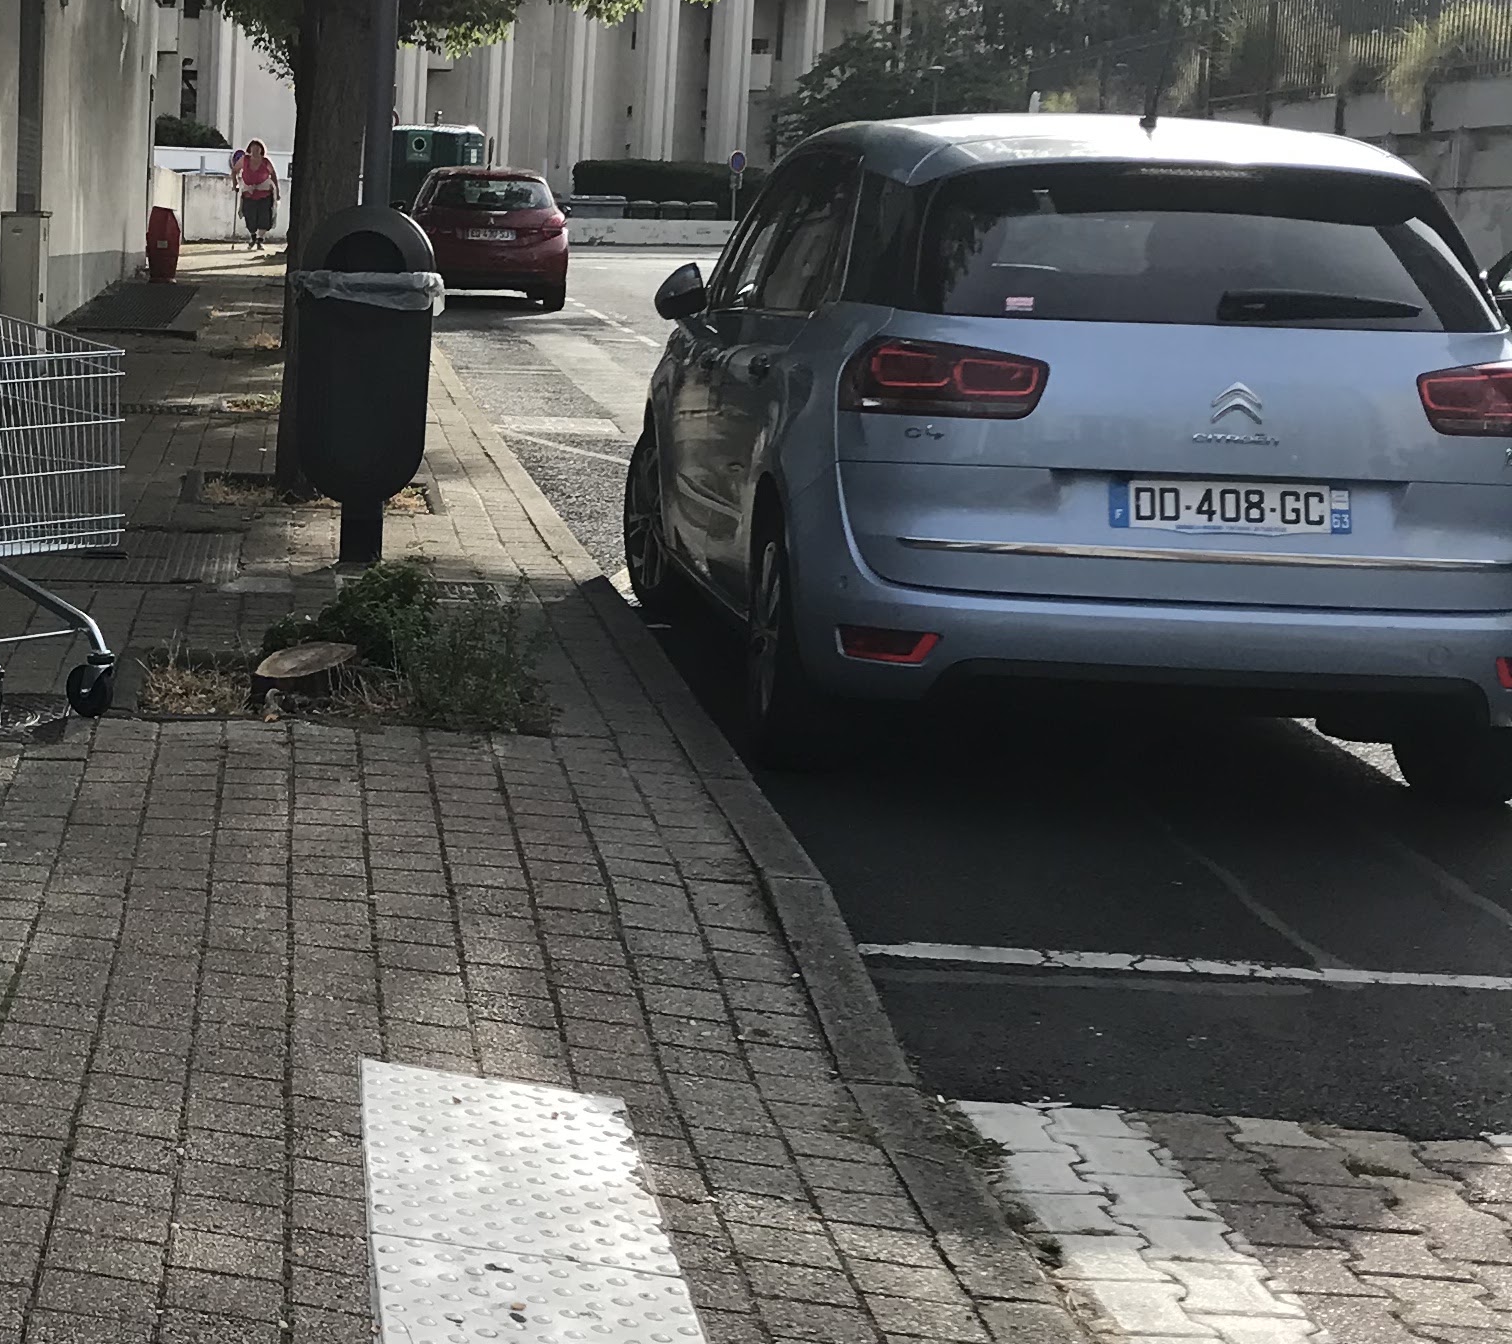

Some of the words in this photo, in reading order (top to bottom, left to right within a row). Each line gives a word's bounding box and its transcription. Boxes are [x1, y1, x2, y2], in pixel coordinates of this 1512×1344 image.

[1135, 487, 1325, 525] DD-408-GC
[1114, 509, 1123, 520] F
[1331, 514, 1350, 529] 63
